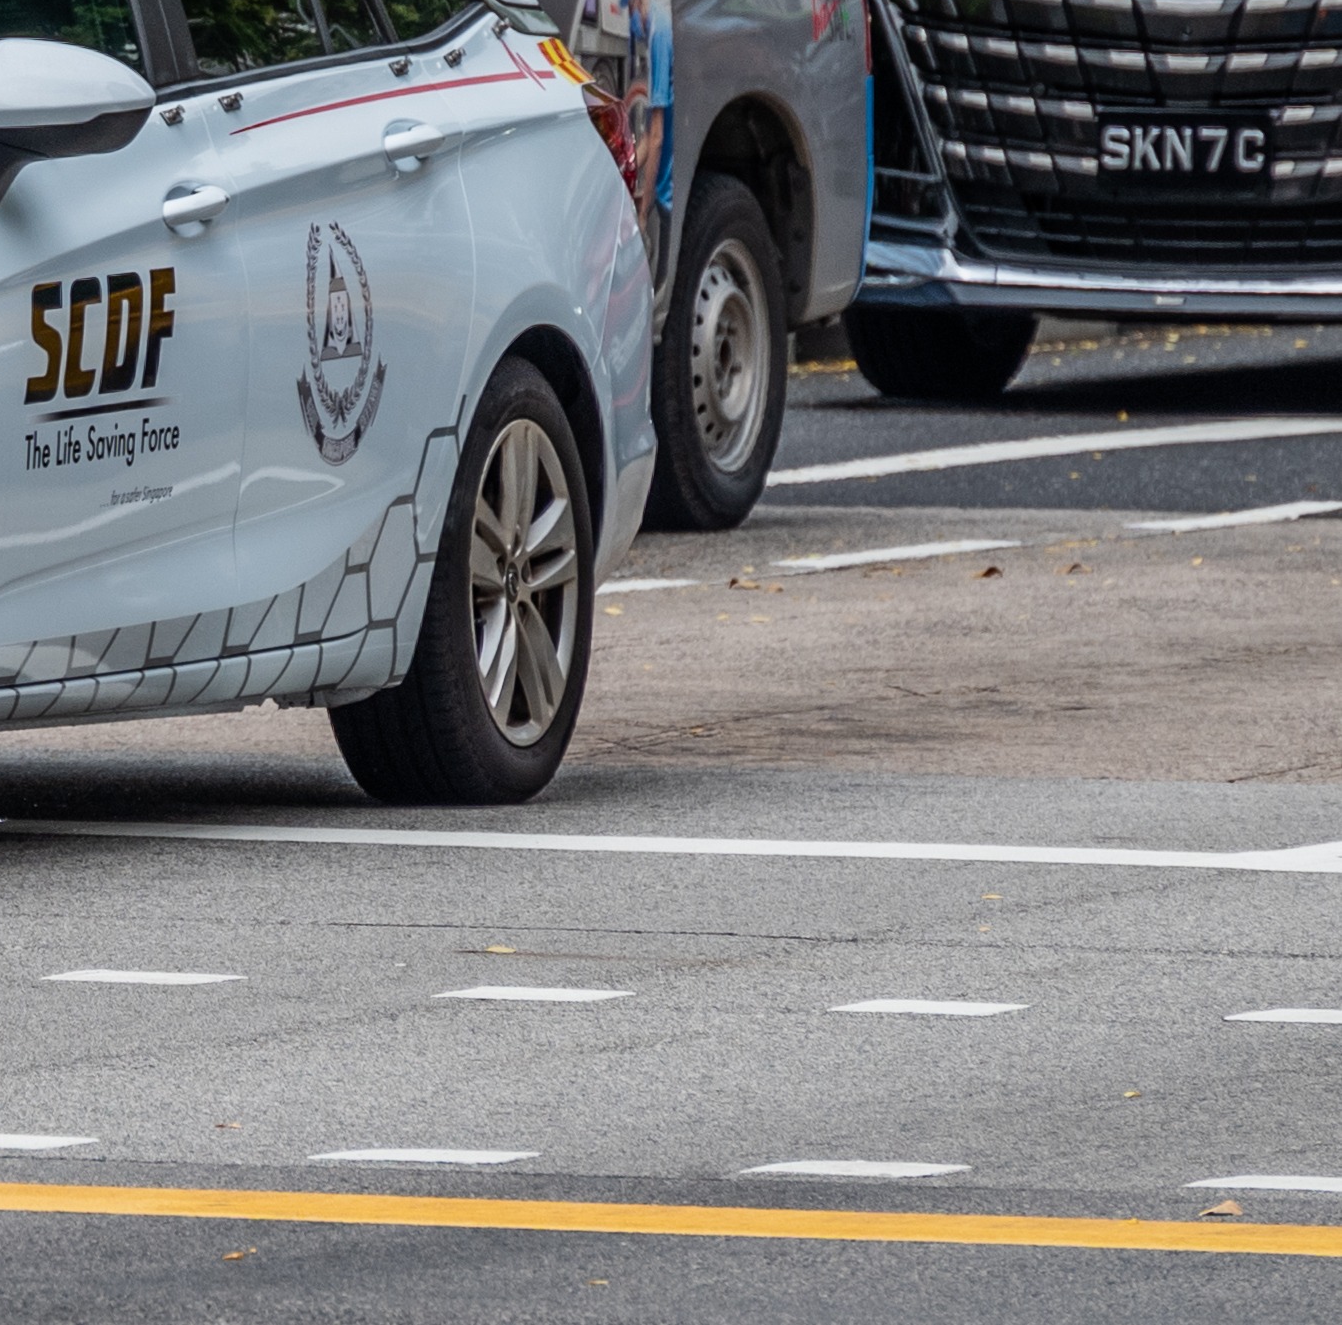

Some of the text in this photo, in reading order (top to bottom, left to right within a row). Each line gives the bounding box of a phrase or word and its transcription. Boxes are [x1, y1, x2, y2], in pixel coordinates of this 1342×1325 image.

[1100, 125, 1266, 173] SKN7C
[23, 267, 176, 405] SCDF
[24, 417, 181, 472] The Life Saving Force
